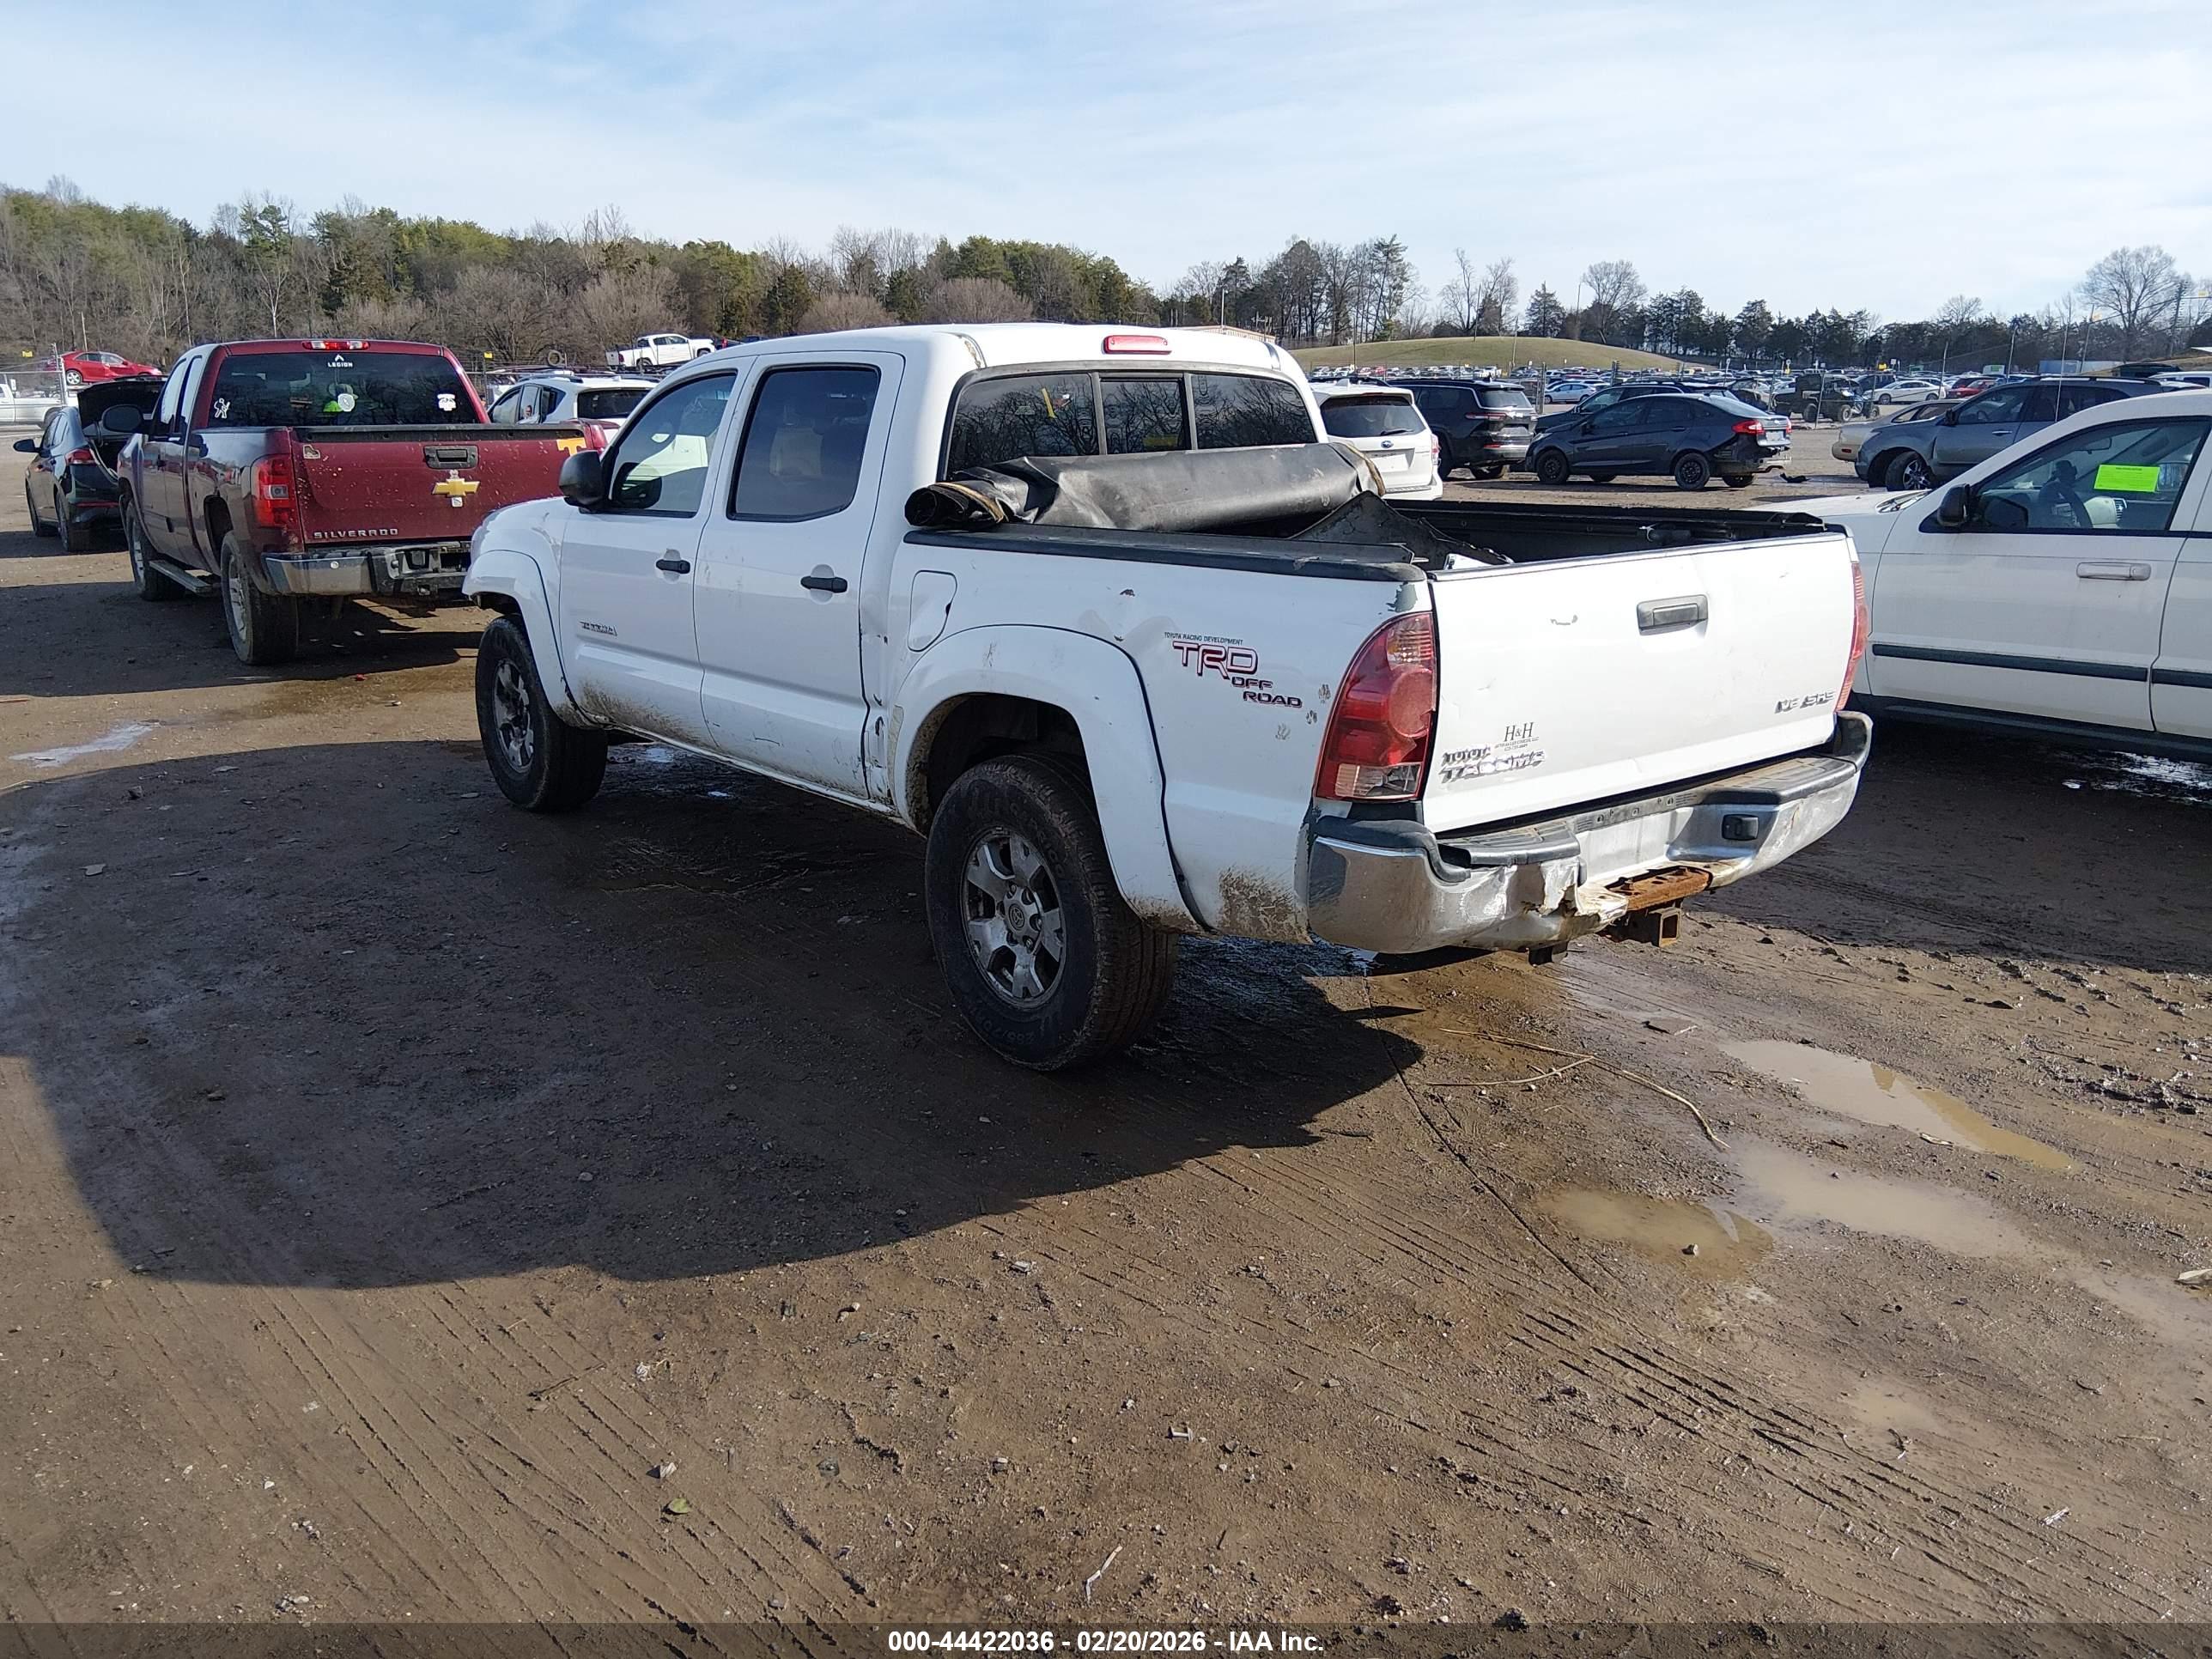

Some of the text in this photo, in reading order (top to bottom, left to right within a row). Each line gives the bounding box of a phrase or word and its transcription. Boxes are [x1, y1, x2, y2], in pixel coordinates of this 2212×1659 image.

[313, 528, 398, 539] SILVERADO
[1164, 631, 1182, 640] TOYOTA
[1203, 635, 1243, 646] DEVELOPMENT
[1172, 641, 1258, 680] TRD
[1231, 676, 1273, 690] OFF
[1243, 690, 1303, 708] ROAD
[1504, 721, 1534, 742] H&H
